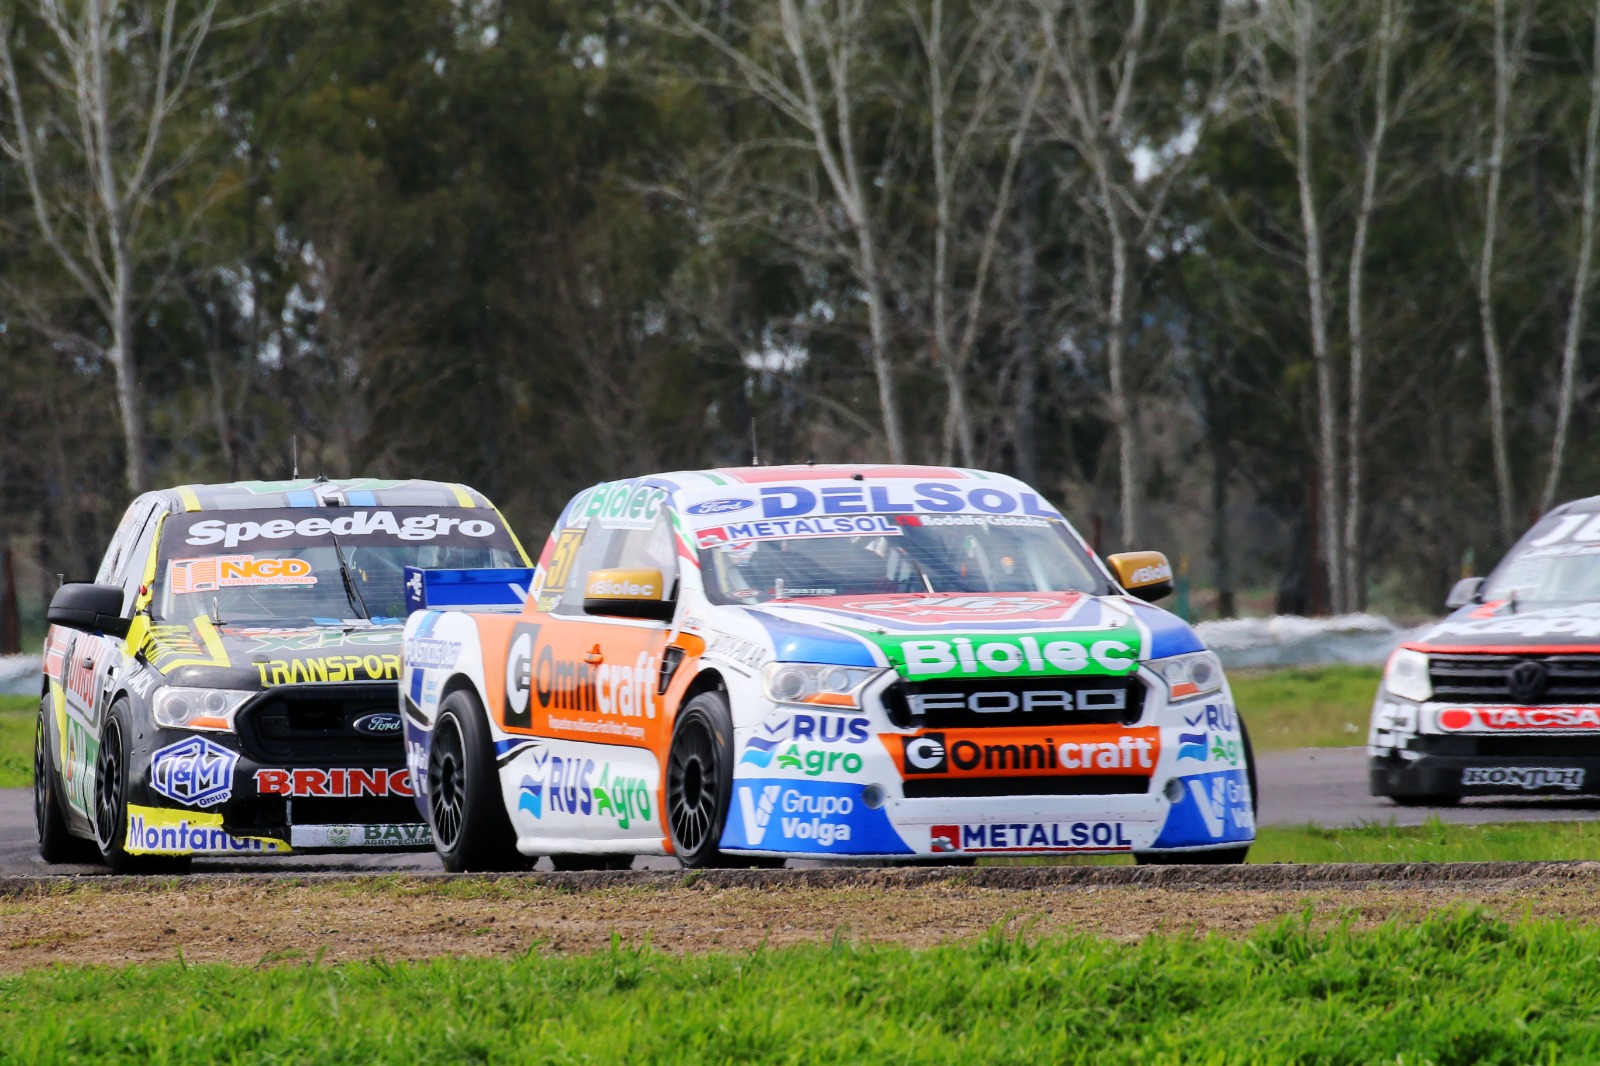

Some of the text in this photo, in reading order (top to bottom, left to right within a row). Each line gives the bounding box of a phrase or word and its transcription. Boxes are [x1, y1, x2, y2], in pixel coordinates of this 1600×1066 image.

[584, 480, 665, 520] Biolec
[697, 499, 742, 515] Ford
[760, 483, 1063, 521] DELSOL
[184, 511, 496, 547] SpeedAgro
[727, 516, 898, 538] METALSOL
[919, 514, 984, 526] Rodolfo
[221, 559, 310, 577] NGD
[221, 576, 316, 584] CONSTRUCCIONES
[594, 580, 654, 596] Biolec
[901, 636, 1136, 674] Biolec
[536, 644, 656, 719] Omnicraft
[911, 689, 1126, 714] FORD
[368, 716, 401, 731] Ford
[793, 715, 871, 744] RUS
[776, 744, 863, 776] Agro
[951, 736, 1152, 770] Omnicraft
[199, 792, 228, 806] Group
[550, 756, 651, 829] RUS Agro
[782, 789, 853, 818] Grupo
[782, 817, 851, 846] Volga
[963, 823, 1132, 847] METALSOL
